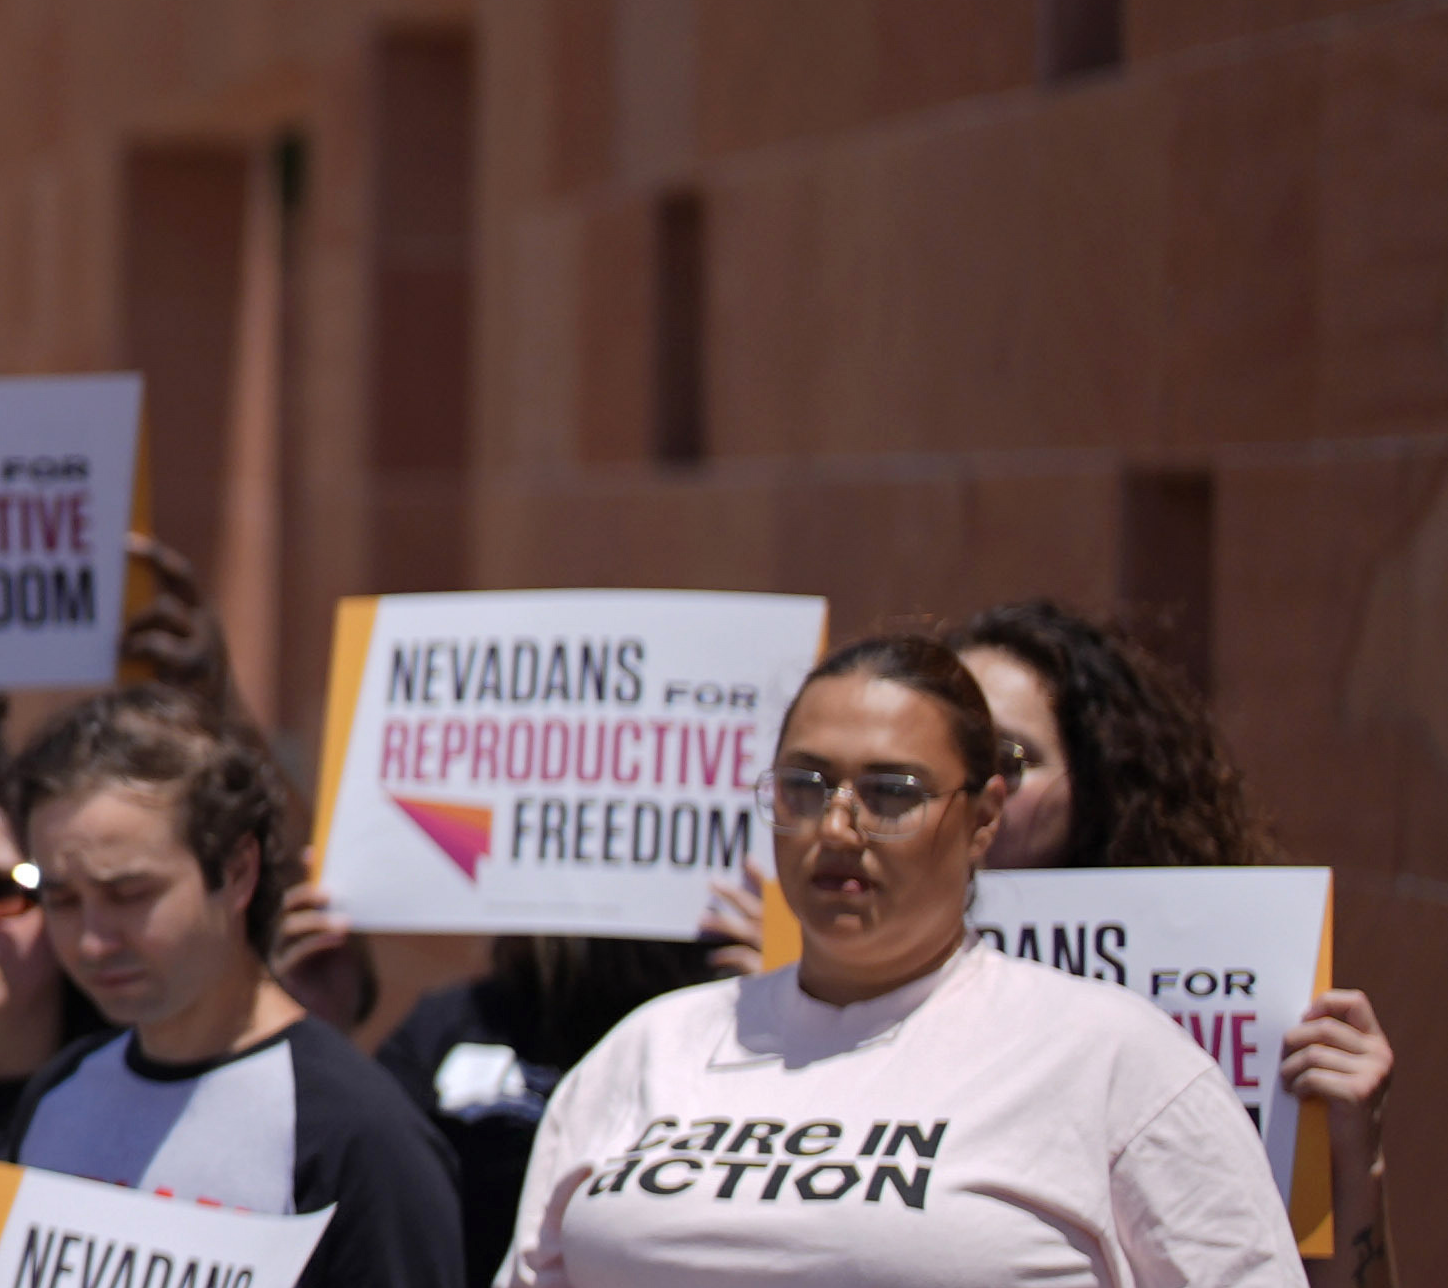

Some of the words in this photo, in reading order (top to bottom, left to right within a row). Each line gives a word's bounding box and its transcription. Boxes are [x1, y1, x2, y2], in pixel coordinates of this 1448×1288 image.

[1, 456, 89, 481] FOR
[388, 638, 644, 708] NEVADANS
[664, 681, 755, 709] FOR
[381, 716, 754, 789] REPRODUCTIVE
[511, 797, 751, 871] FREEDOM
[1151, 970, 1256, 996] FOR
[858, 1120, 948, 1159] IN
